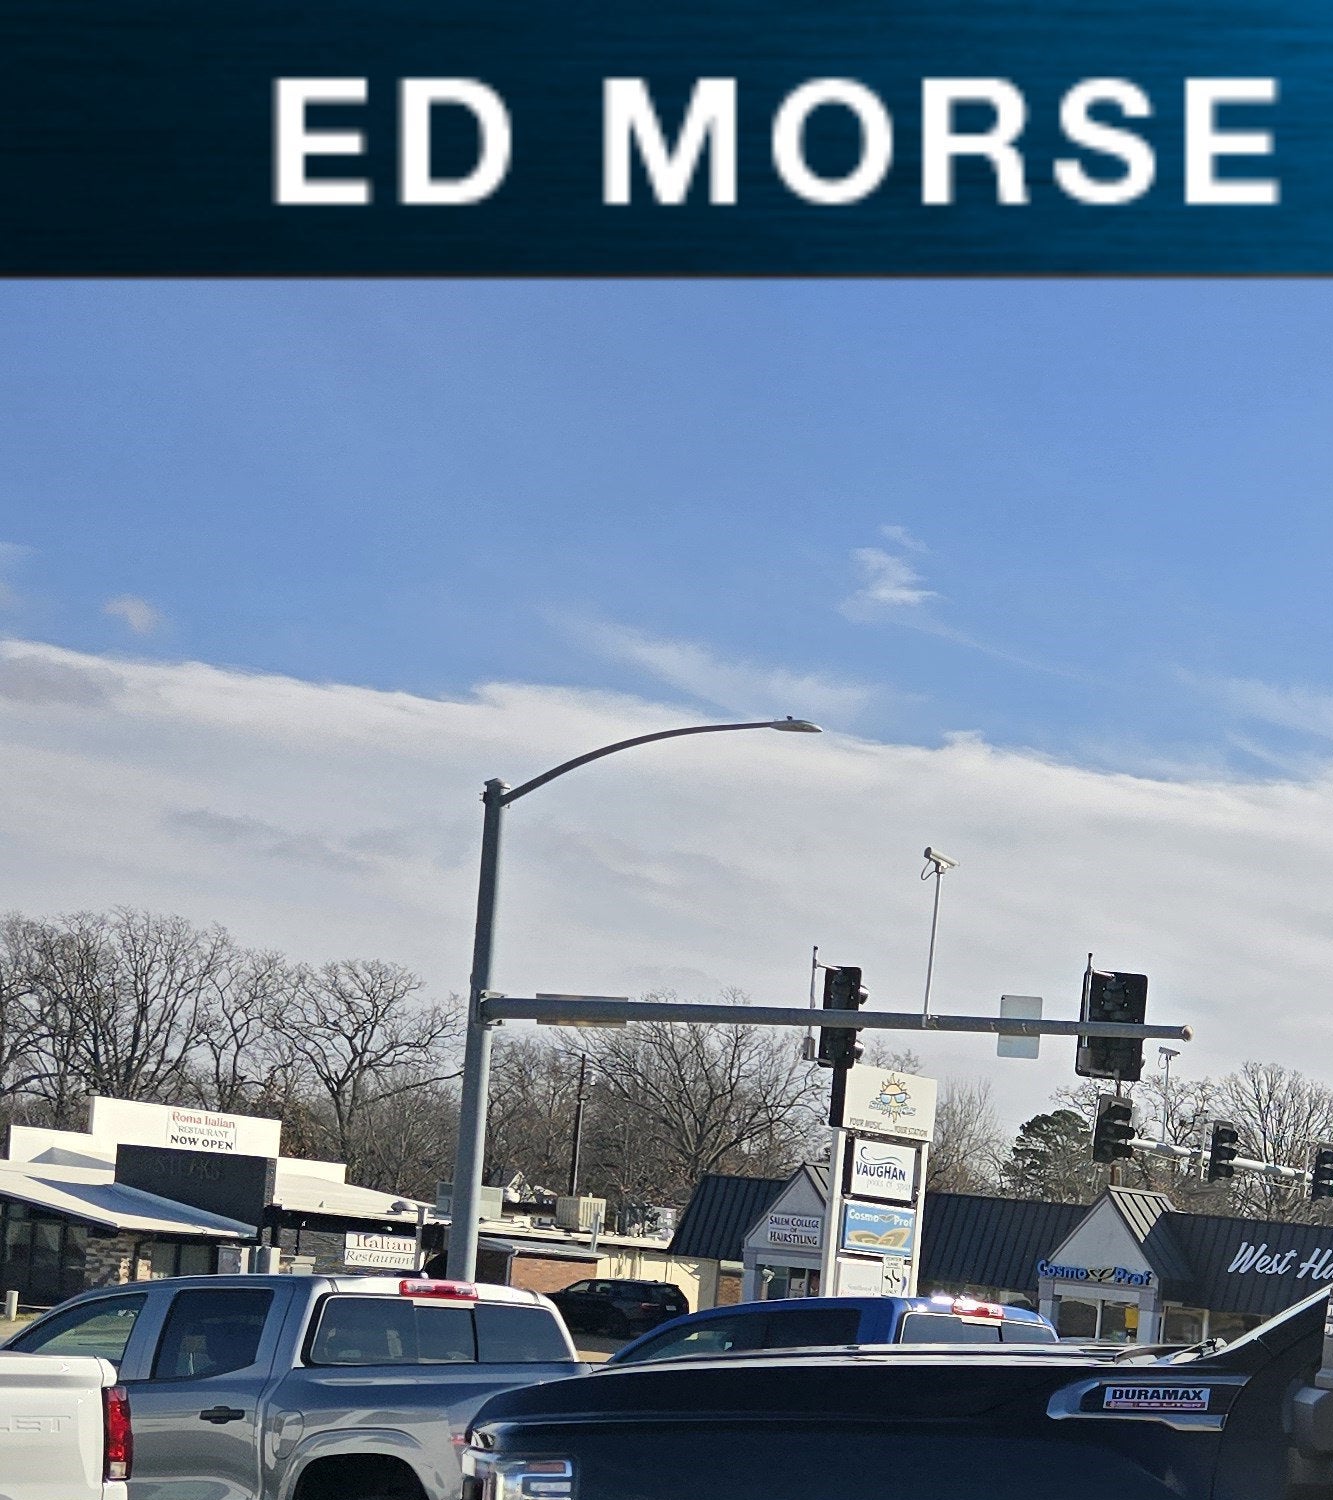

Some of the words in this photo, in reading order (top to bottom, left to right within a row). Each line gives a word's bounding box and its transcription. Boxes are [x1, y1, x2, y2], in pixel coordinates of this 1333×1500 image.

[172, 1111, 202, 1124] Roma
[205, 1115, 235, 1129] Italian
[170, 1134, 199, 1146] NOW
[202, 1139, 233, 1151] OPEN
[856, 1160, 906, 1182] VAUGHAN
[769, 1215, 790, 1226] SALEM
[791, 1217, 820, 1229] COLLEGE
[849, 1208, 879, 1223] Cosmo
[893, 1214, 914, 1227] Prof
[355, 1235, 413, 1252] Italian
[770, 1230, 818, 1246] HAIRSTYLING
[1227, 1241, 1298, 1275] West
[1037, 1259, 1089, 1280] Cosmo
[1114, 1266, 1153, 1286] Prof
[1111, 1389, 1204, 1401] DURAMAX
